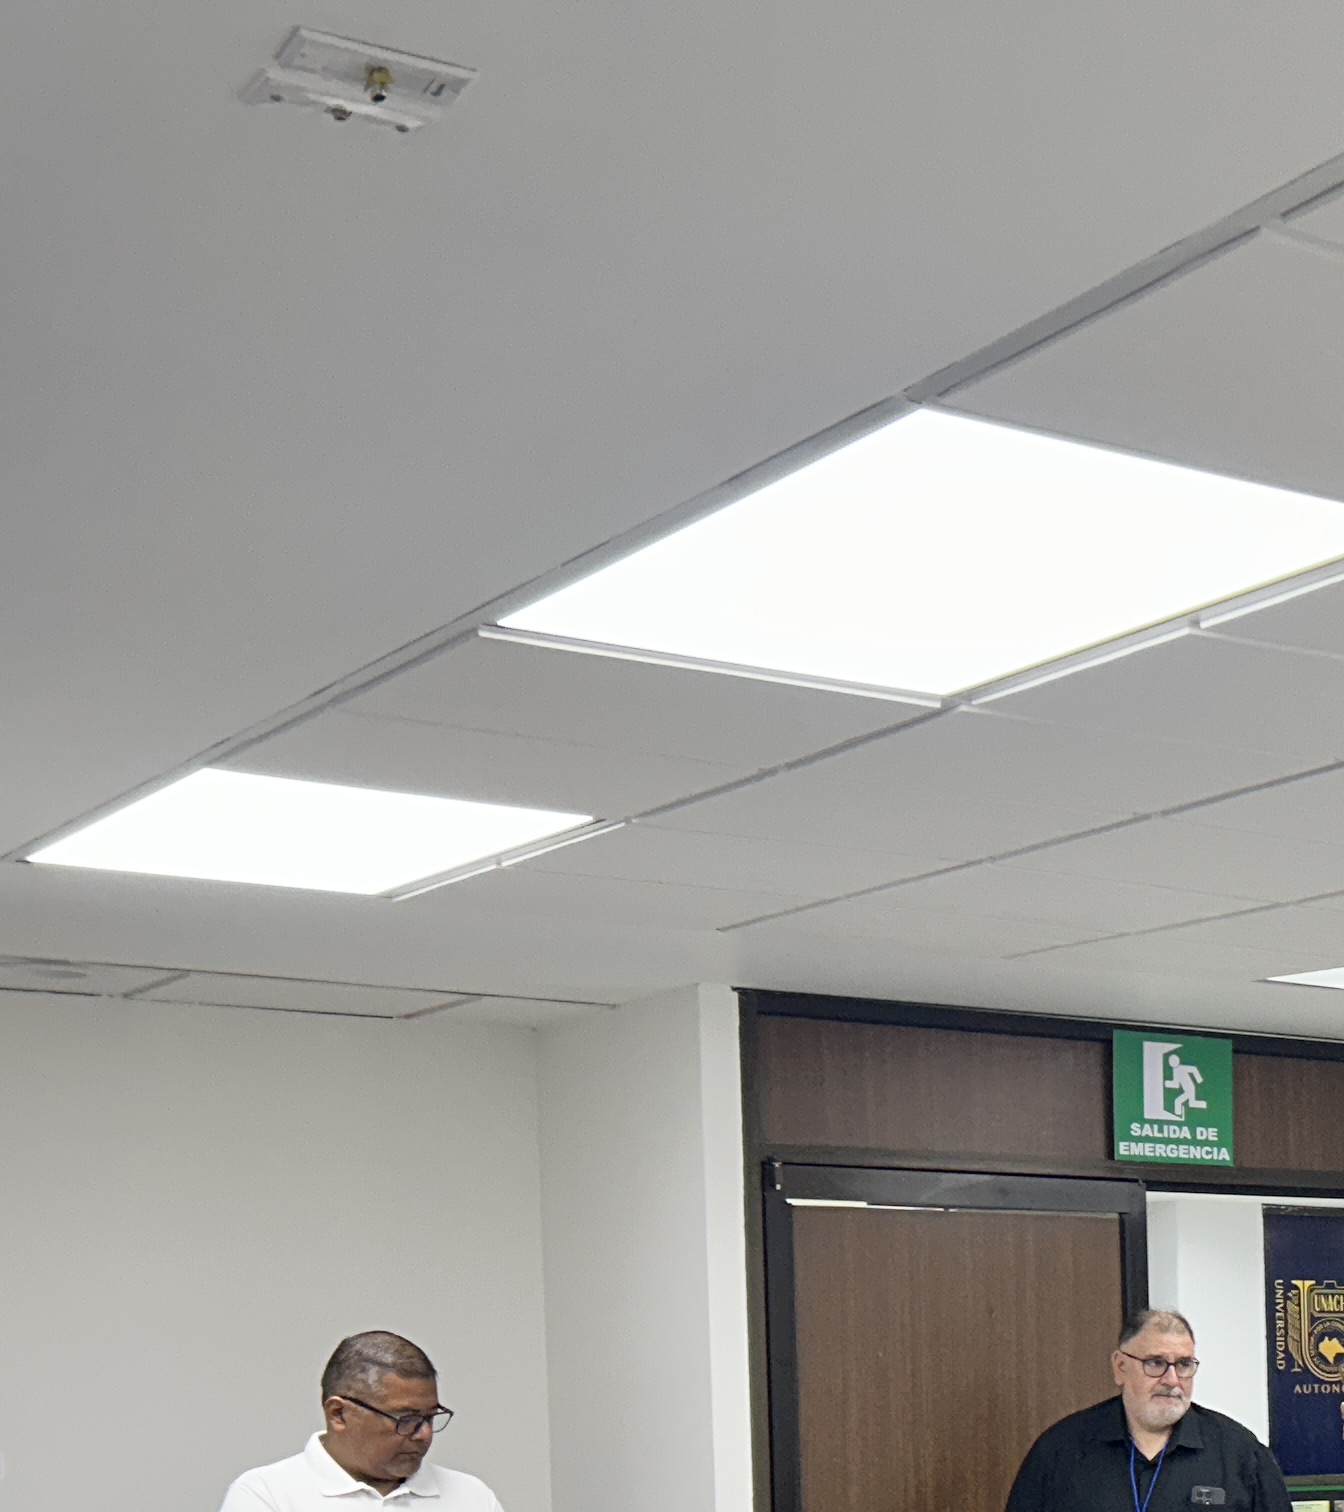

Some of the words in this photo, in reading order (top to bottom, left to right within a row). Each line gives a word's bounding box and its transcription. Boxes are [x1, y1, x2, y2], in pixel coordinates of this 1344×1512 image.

[1129, 1122, 1192, 1140] SALIDA
[1196, 1127, 1219, 1141] DE
[1118, 1141, 1231, 1161] EMERGENCIA
[1273, 1279, 1287, 1371] UNIVERSIDAD
